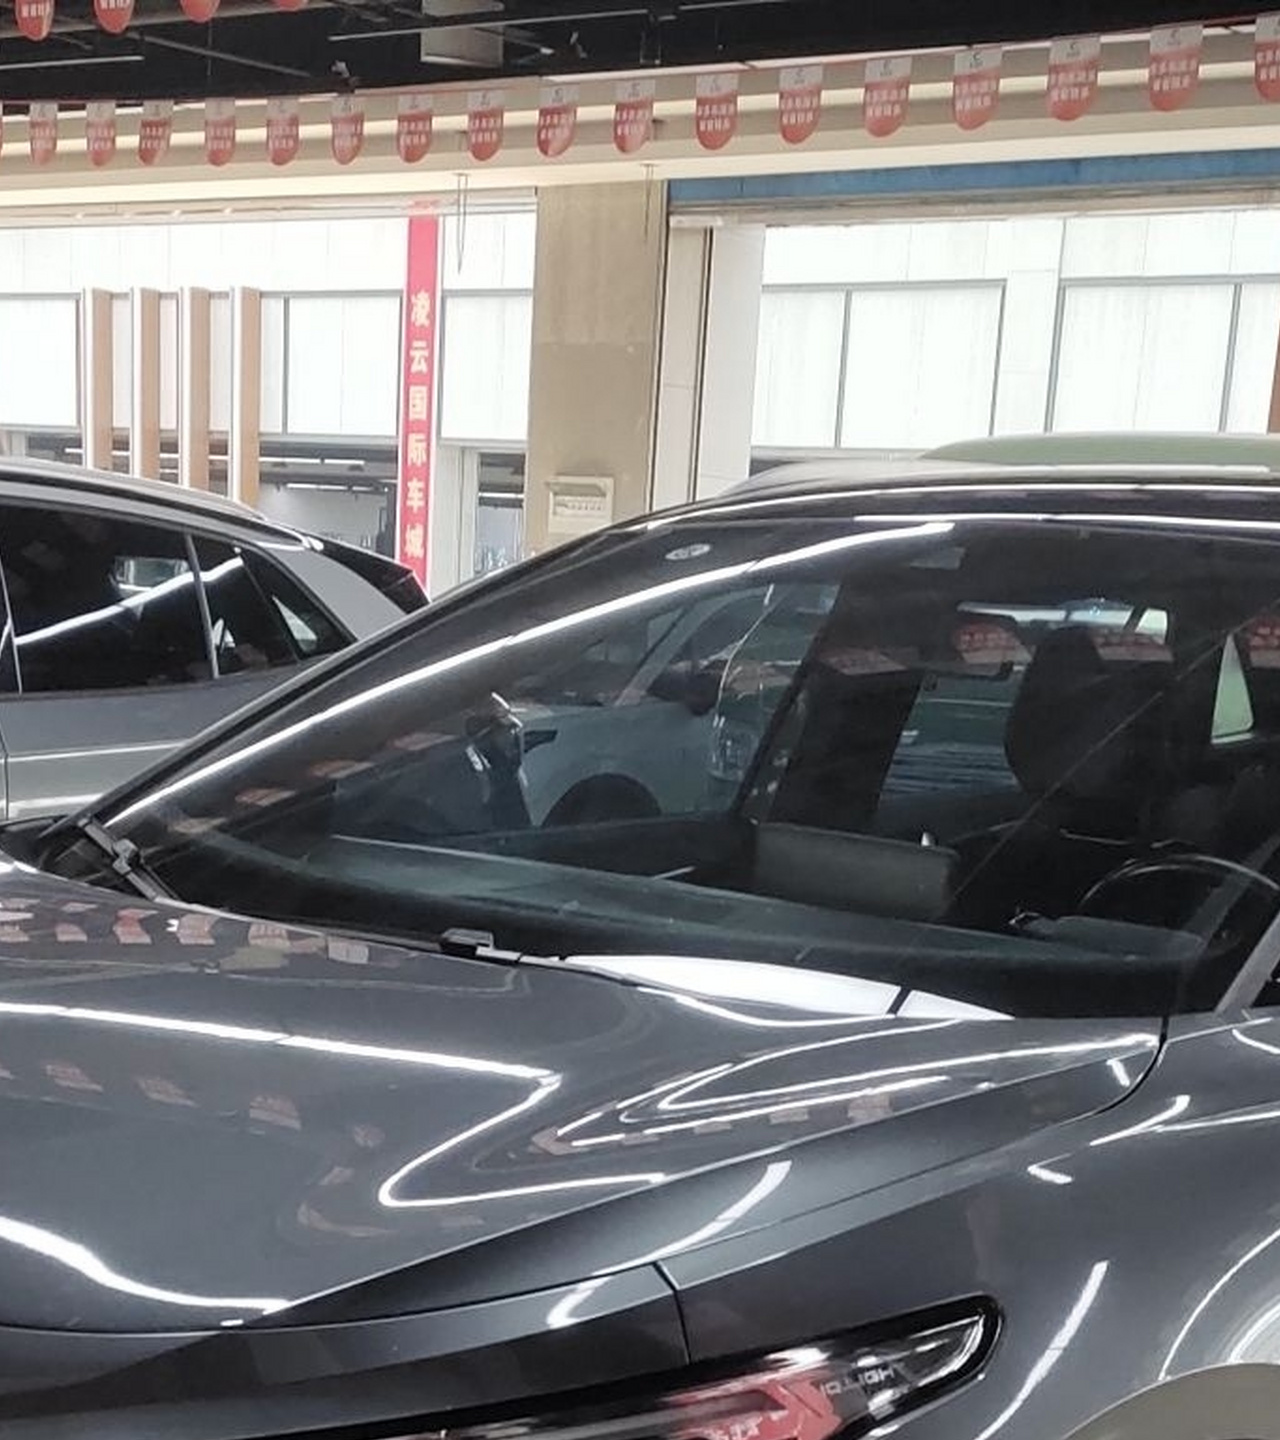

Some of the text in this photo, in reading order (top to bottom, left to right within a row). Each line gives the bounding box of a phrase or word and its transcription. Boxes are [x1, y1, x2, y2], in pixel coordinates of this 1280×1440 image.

[405, 290, 429, 560] 凌云国际车城
